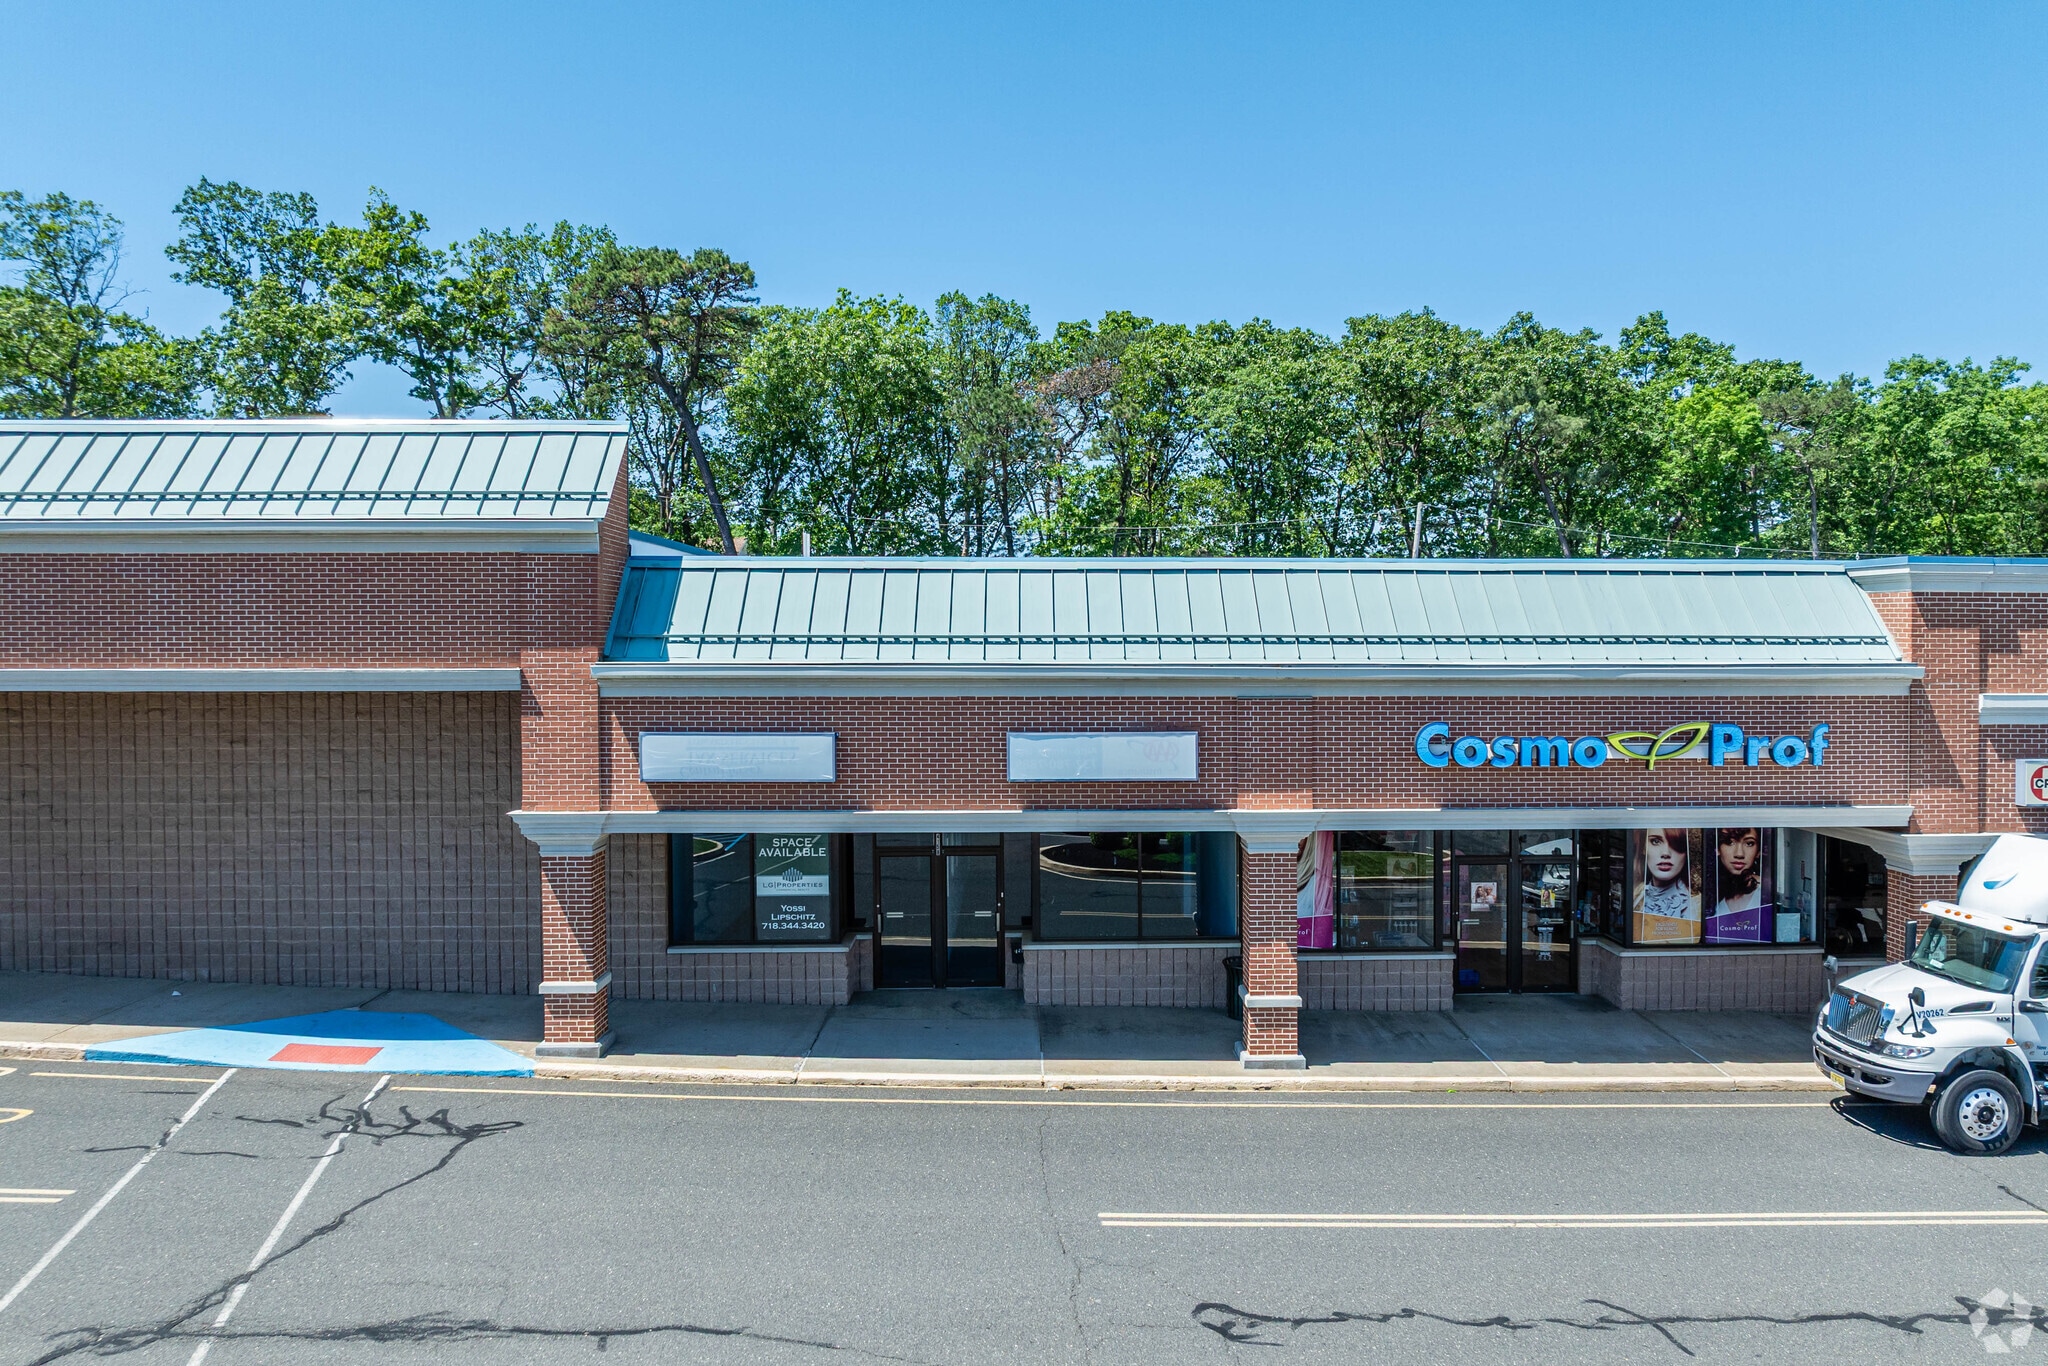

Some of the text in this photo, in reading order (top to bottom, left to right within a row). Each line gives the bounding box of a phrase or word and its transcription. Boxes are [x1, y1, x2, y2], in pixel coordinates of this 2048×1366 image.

[1414, 721, 1831, 768] Cosmo Prof
[772, 838, 812, 847] SPACE
[758, 847, 827, 857] AVAILABLE
[761, 922, 826, 930] 718.344.3420
[1915, 1008, 1945, 1019] V20262
